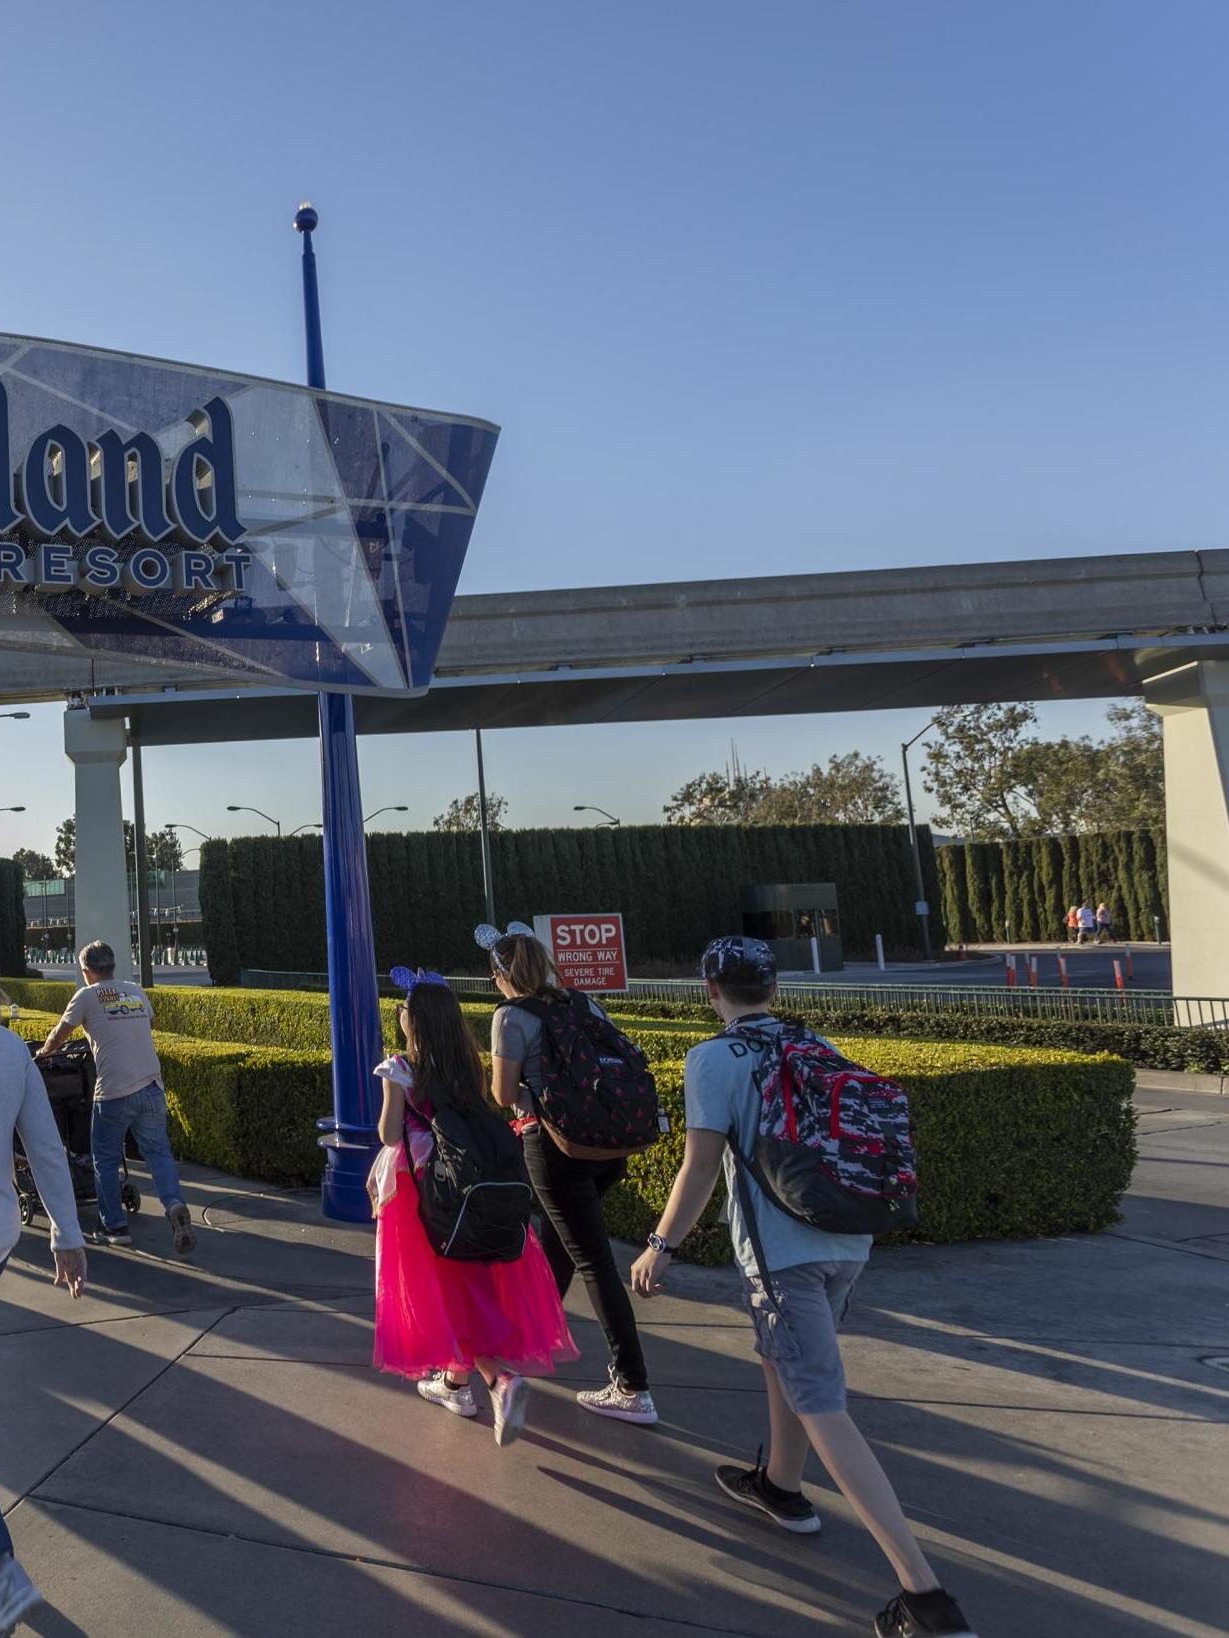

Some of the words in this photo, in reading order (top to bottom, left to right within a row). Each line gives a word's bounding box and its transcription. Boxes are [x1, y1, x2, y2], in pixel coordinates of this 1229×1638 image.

[556, 924, 616, 945] STOP
[557, 951, 592, 962] WRONG
[597, 951, 617, 961] WAY
[564, 968, 594, 977] SEVERE
[598, 967, 615, 975] TIRE
[574, 977, 607, 986] DAMAGE
